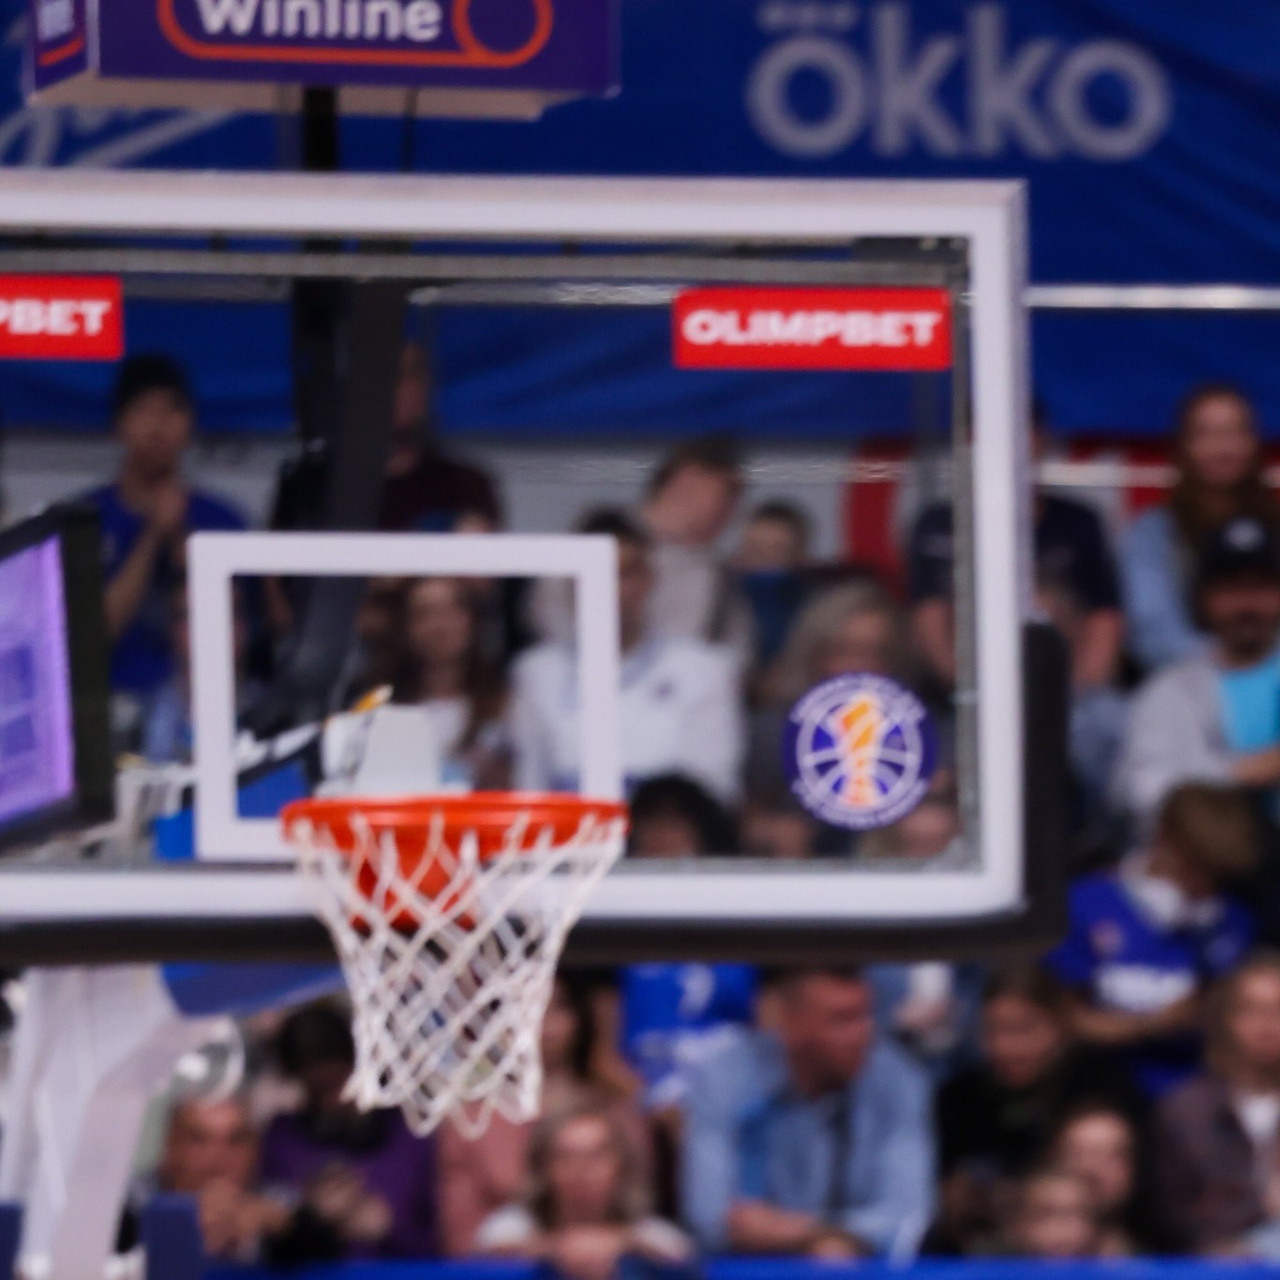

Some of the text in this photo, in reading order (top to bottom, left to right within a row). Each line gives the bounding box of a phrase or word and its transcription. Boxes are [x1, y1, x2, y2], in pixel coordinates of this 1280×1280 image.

[197, 0, 443, 42] Winline
[0, 298, 112, 336] BET
[682, 308, 942, 347] OLIMPBET
